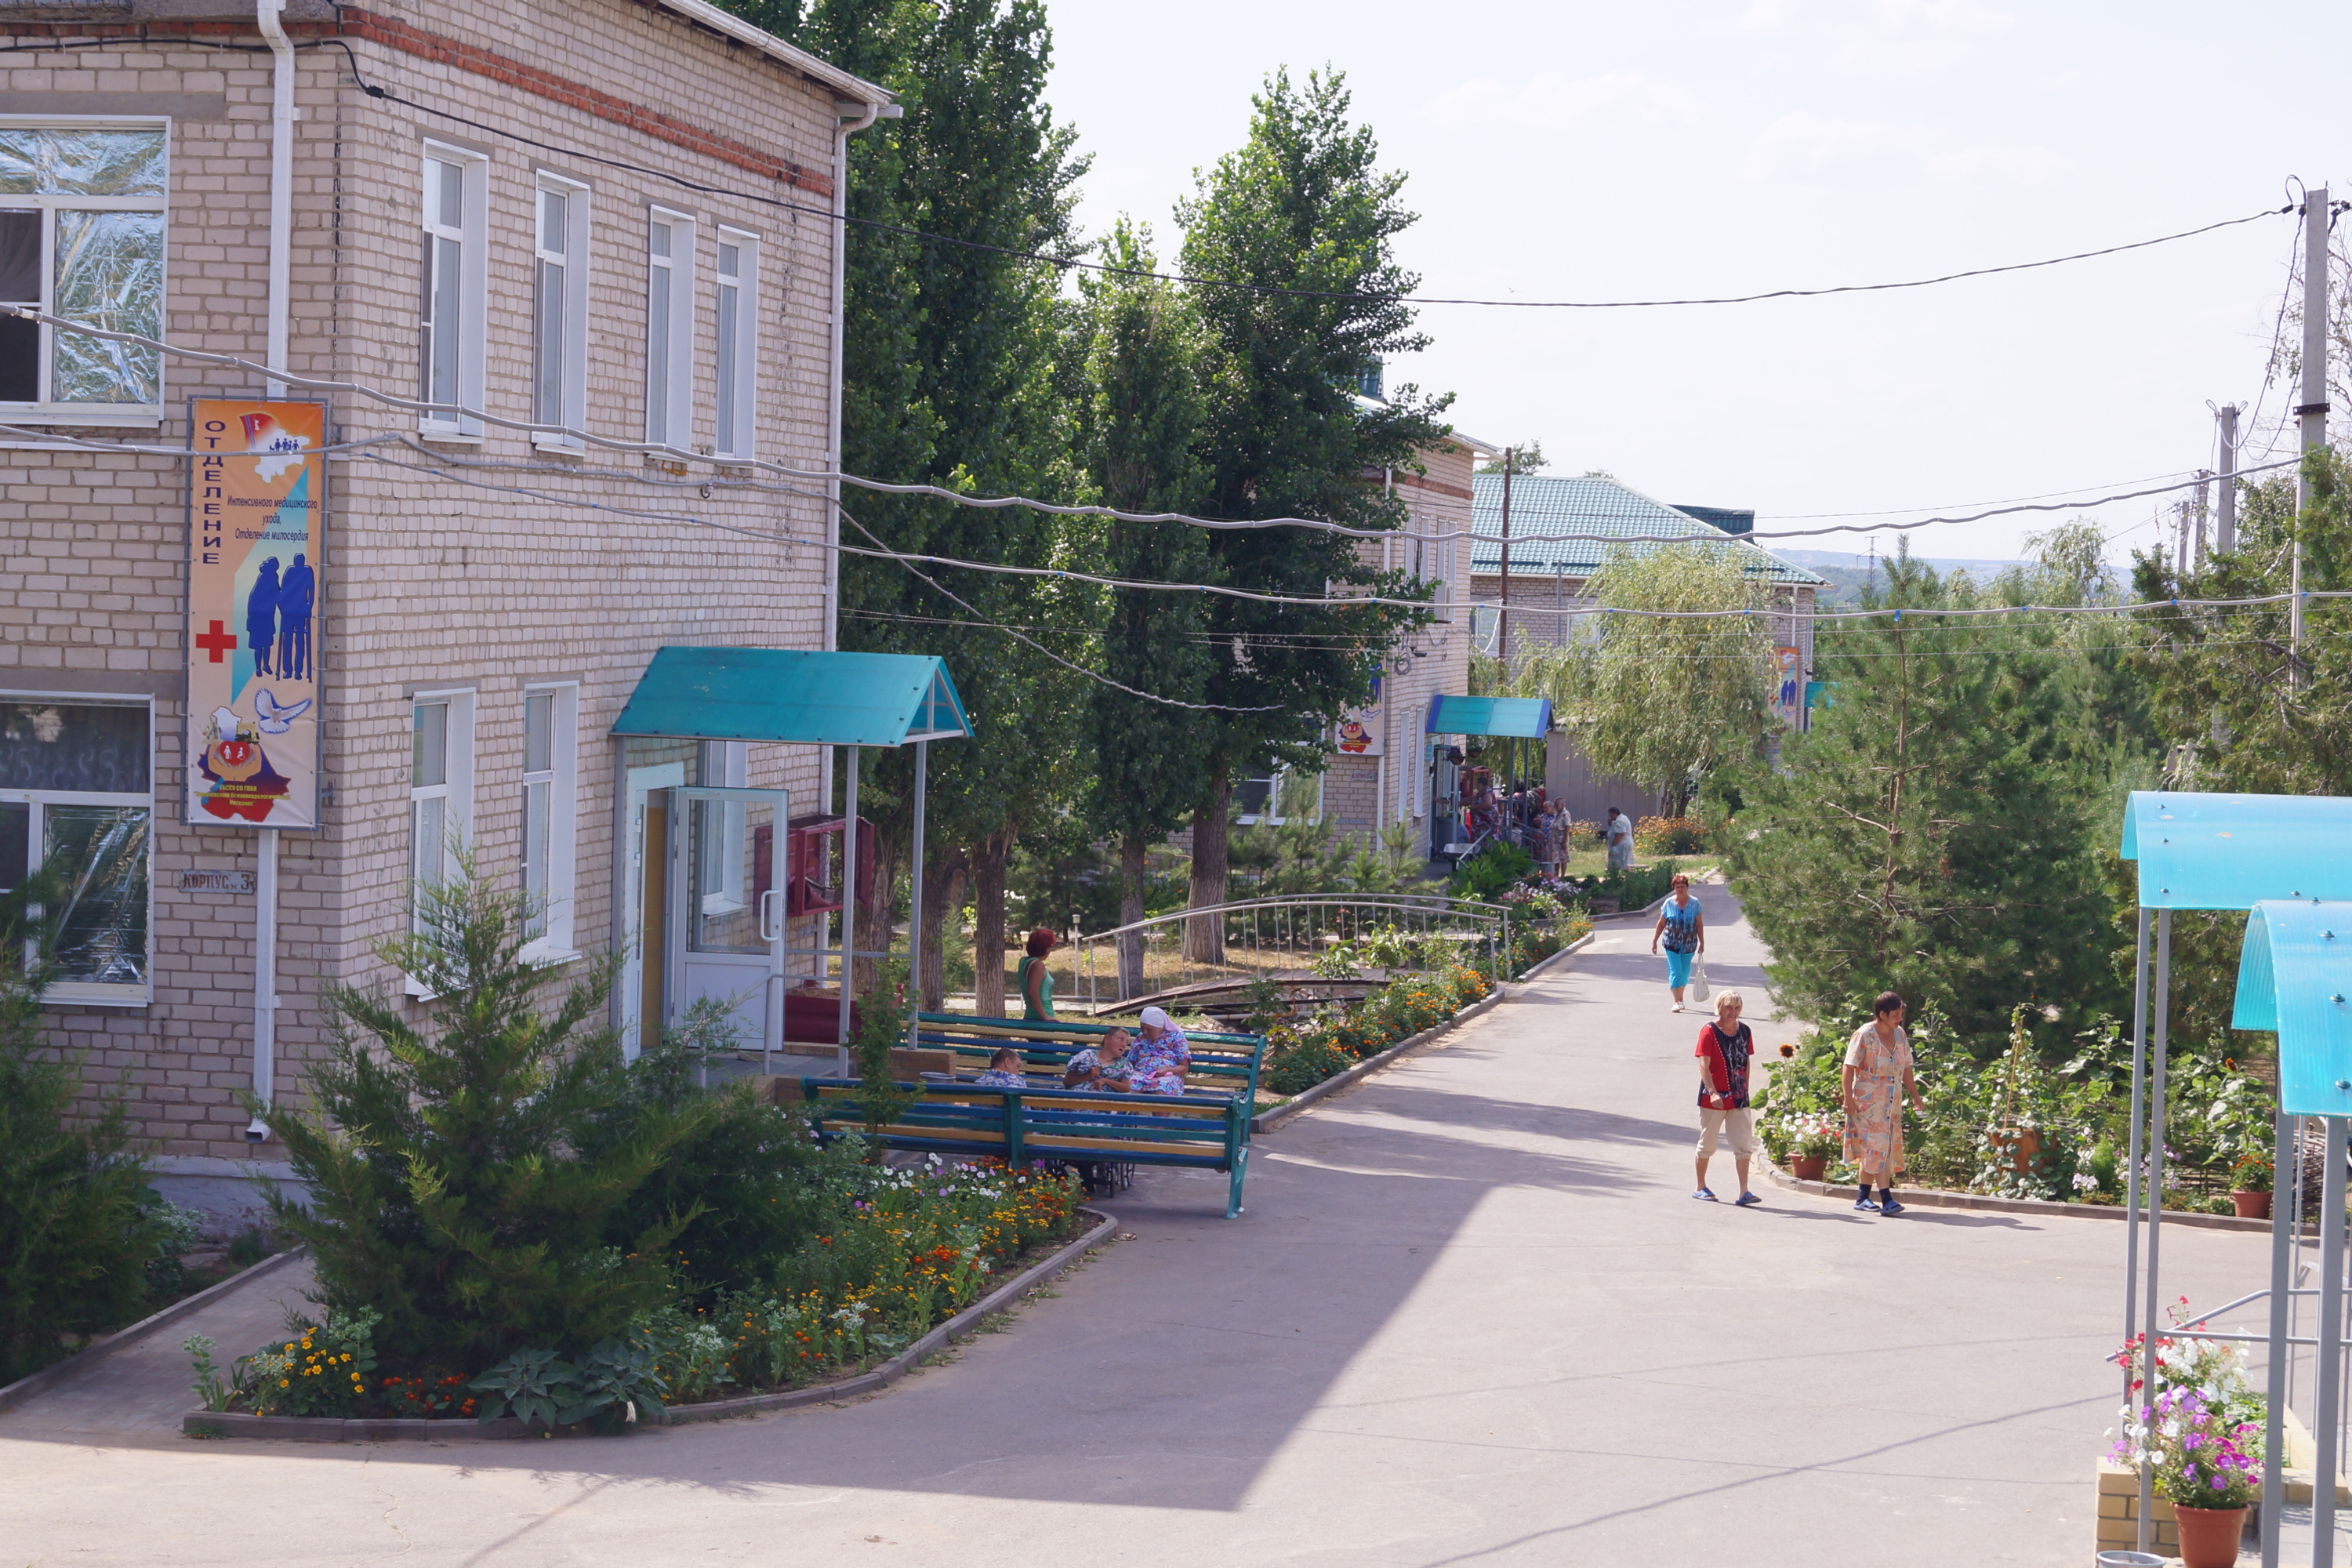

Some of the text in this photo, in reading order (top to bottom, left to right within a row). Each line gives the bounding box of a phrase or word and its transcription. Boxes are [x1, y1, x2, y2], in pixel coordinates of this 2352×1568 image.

[202, 420, 226, 564] ОТДЕЛЕНИЕ
[227, 495, 318, 510] Интенсивного медицинского
[262, 512, 281, 526] ухода,
[235, 528, 309, 543] Отделение милосердия
[183, 873, 229, 889] КОРПУС
[241, 873, 250, 890] 3
